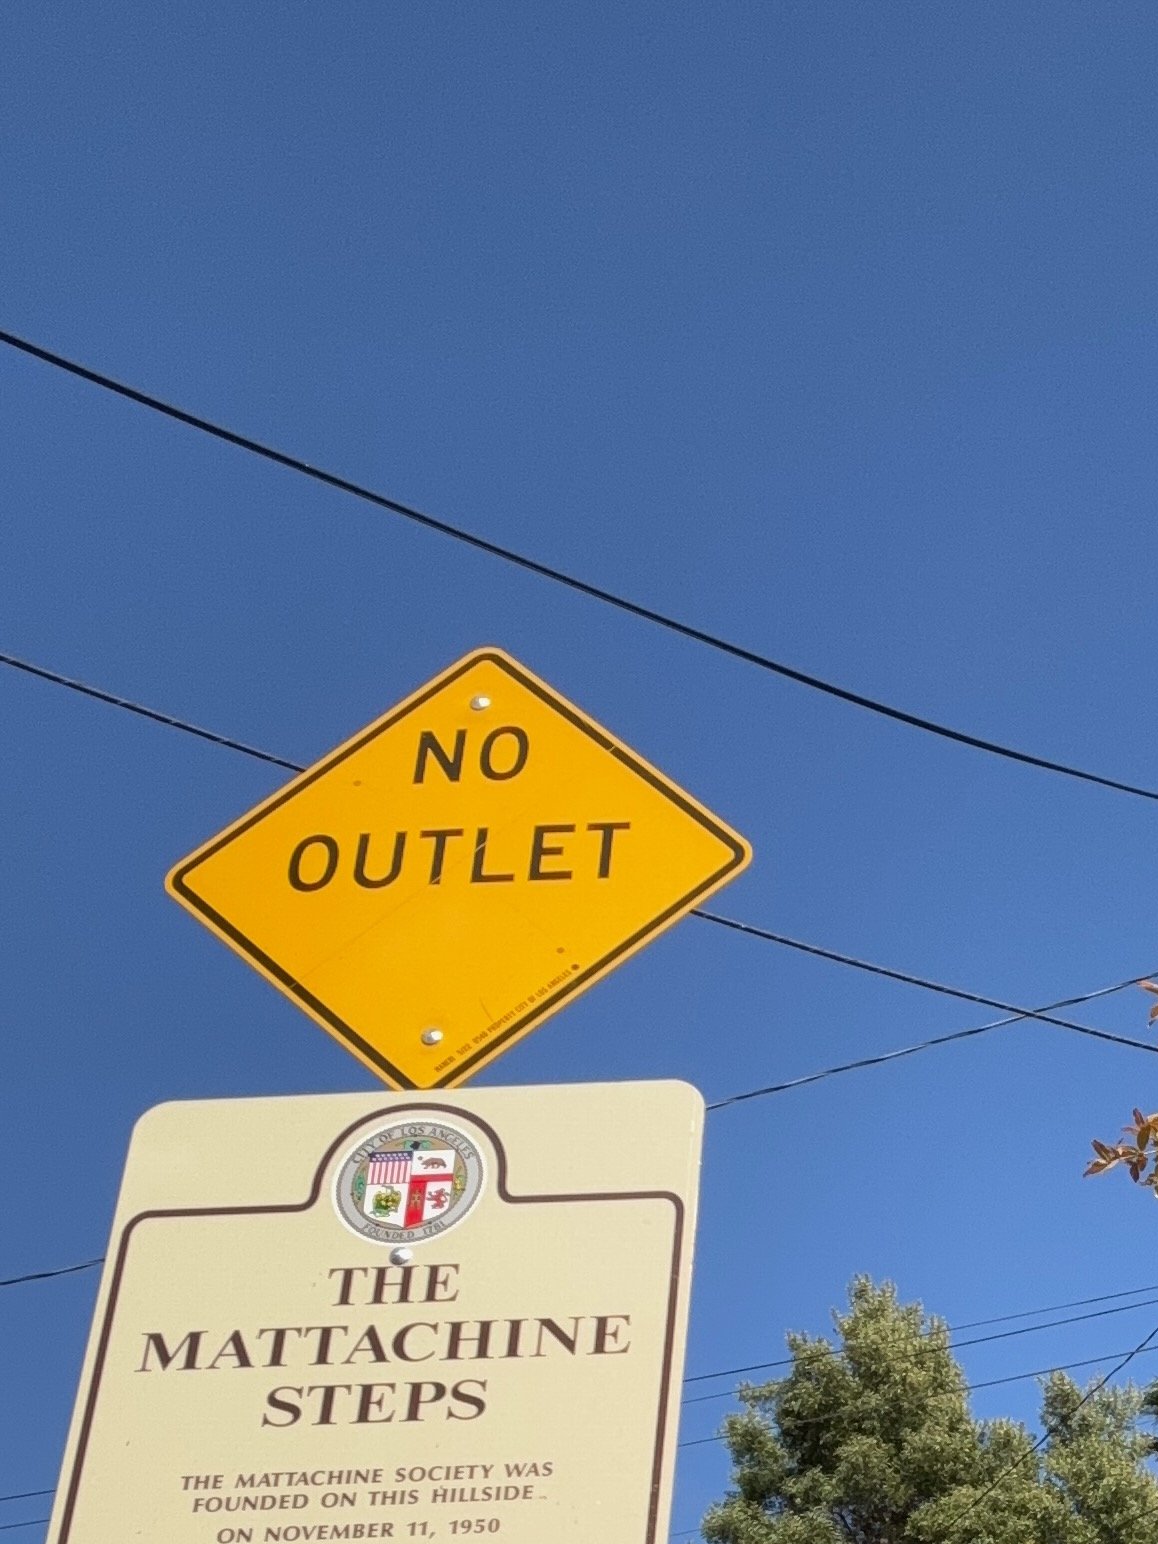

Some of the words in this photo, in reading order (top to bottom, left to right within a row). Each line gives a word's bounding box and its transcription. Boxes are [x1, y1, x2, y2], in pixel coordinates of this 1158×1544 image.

[412, 725, 530, 784] NO
[288, 822, 631, 892] OUTLET
[352, 1138, 378, 1164] CITY
[379, 1132, 394, 1144] OF
[401, 1126, 425, 1135] LOS
[429, 1127, 476, 1160] ANGELES
[361, 1223, 415, 1239] FOUNDED
[422, 1221, 445, 1235] 1781
[328, 1263, 460, 1307] THE
[134, 1314, 632, 1373] MATTACHINE
[261, 1379, 487, 1427] STEPS
[181, 1474, 224, 1492] THE
[235, 1468, 384, 1489] MATTACHINE
[395, 1464, 495, 1484] SOCIETY
[504, 1461, 554, 1478] WAS
[192, 1493, 309, 1513] FOUNDED
[320, 1491, 356, 1510] ON
[368, 1489, 419, 1508] THIS
[431, 1485, 534, 1504] HILLSIDE
[216, 1527, 253, 1544] ON
[264, 1522, 395, 1543] NOVEMBER
[406, 1521, 436, 1540] 11,
[449, 1518, 501, 1536] 1950
